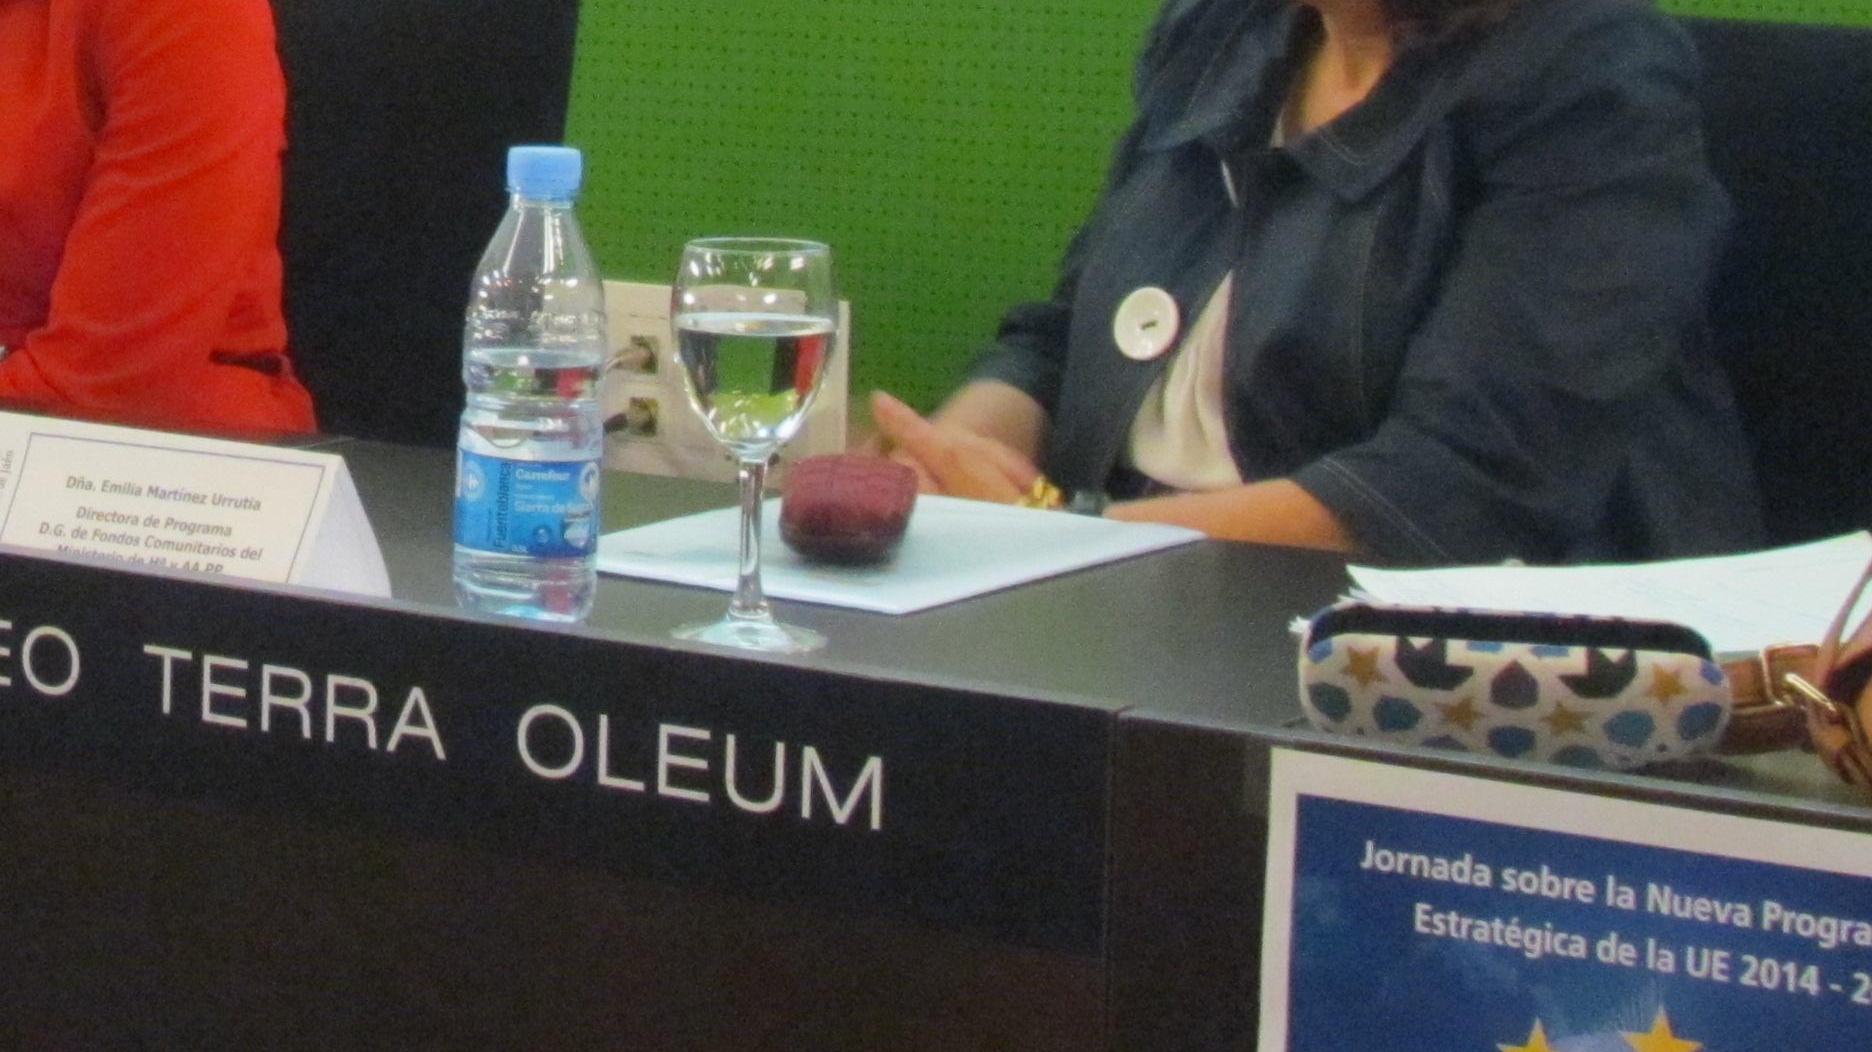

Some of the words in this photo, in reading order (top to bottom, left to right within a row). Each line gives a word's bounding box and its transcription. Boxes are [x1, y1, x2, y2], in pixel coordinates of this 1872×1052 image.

[65, 476, 96, 491] Dña.
[101, 479, 142, 497] Emilia
[211, 493, 262, 511] Urrutia
[76, 506, 139, 526] Directora
[143, 515, 161, 529] de
[163, 516, 233, 538] Programa
[71, 525, 88, 540] de
[91, 528, 141, 547] Fondos
[144, 534, 237, 558] Comunitarios
[240, 546, 264, 561] del
[143, 643, 447, 761] TERRA
[516, 702, 885, 832] OLEUM
[1359, 839, 1492, 888] Jornada
[1501, 864, 1595, 904] sobre
[1605, 875, 1635, 910] la
[1646, 883, 1752, 929] Nueva
[1414, 903, 1587, 960] Estratégica
[1596, 928, 1635, 967] de
[1646, 937, 1676, 974] la
[1686, 943, 1731, 983] UE
[1739, 953, 1820, 996] 2014
